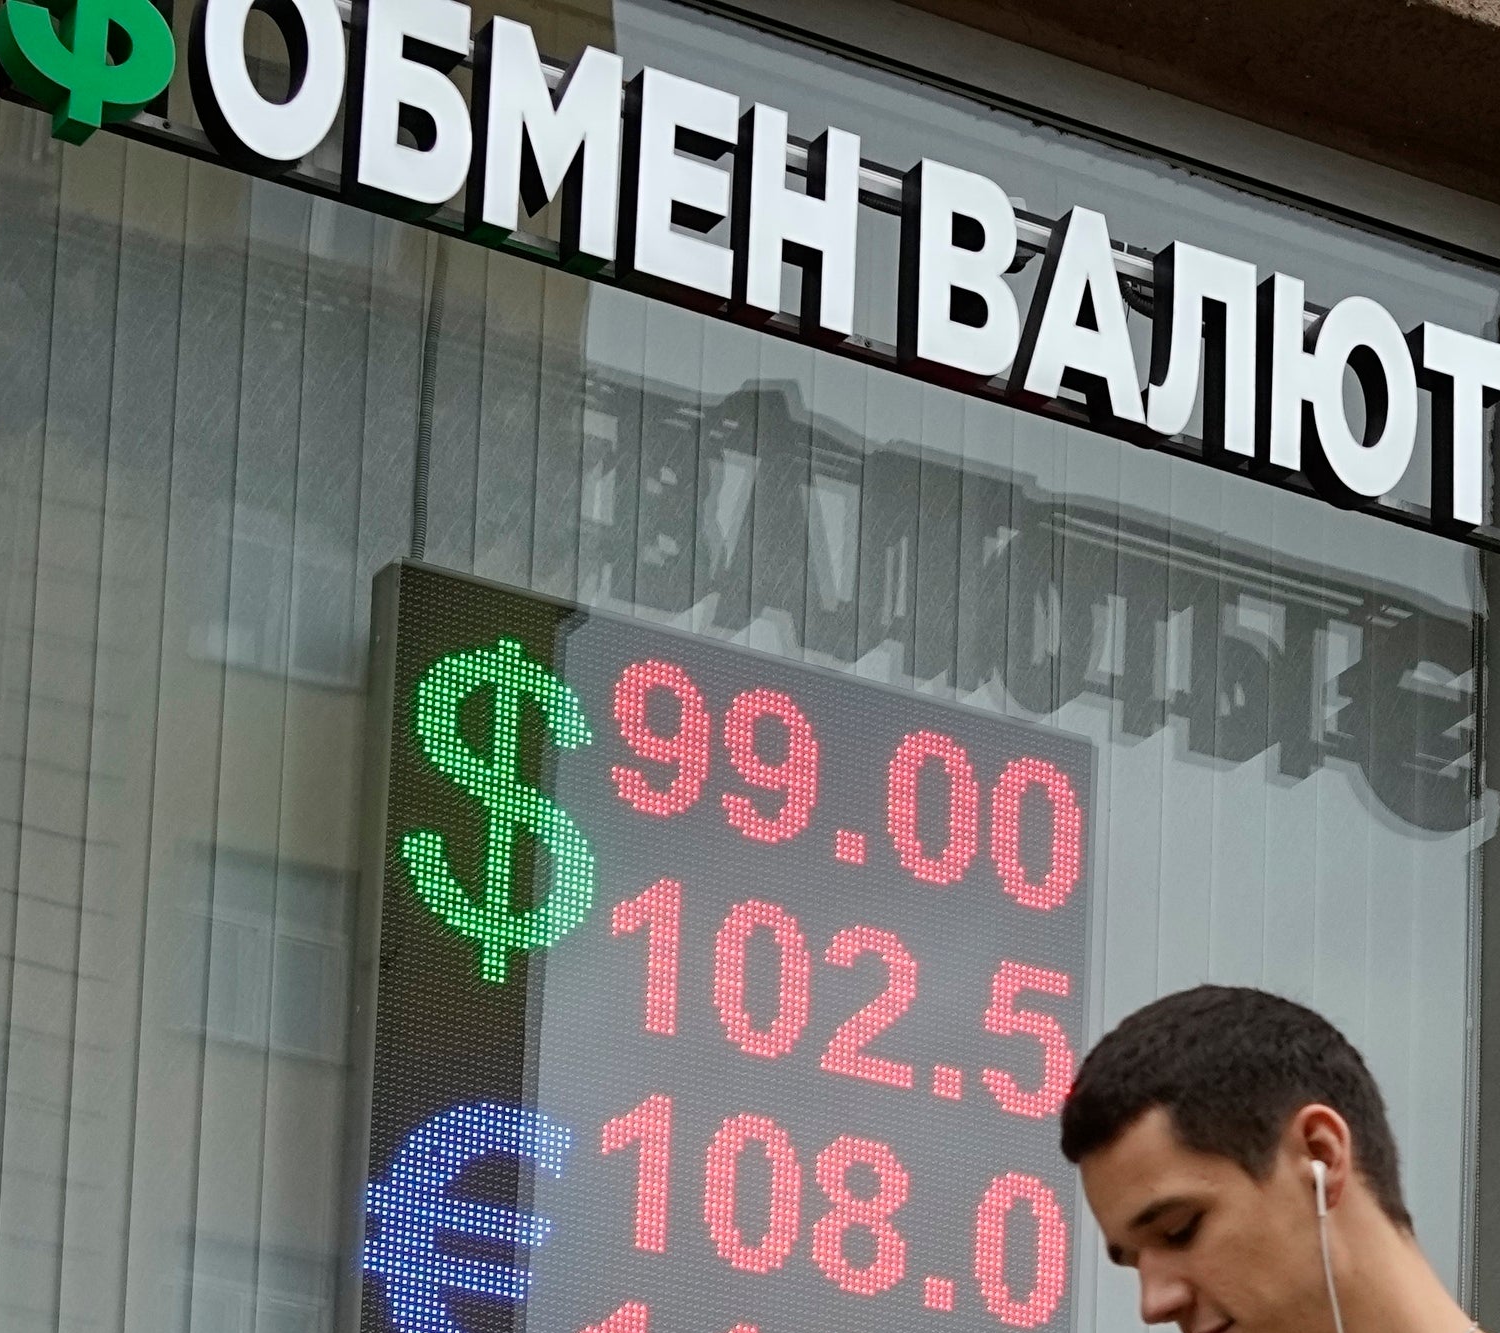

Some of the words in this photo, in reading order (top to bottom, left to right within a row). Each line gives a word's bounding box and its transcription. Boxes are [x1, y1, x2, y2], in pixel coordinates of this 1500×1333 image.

[204, 0, 860, 336] ОБМЕН
[611, 660, 1081, 911] 99.00
[611, 878, 1073, 1118] 102.5
[601, 1094, 1066, 1328] 108.0
